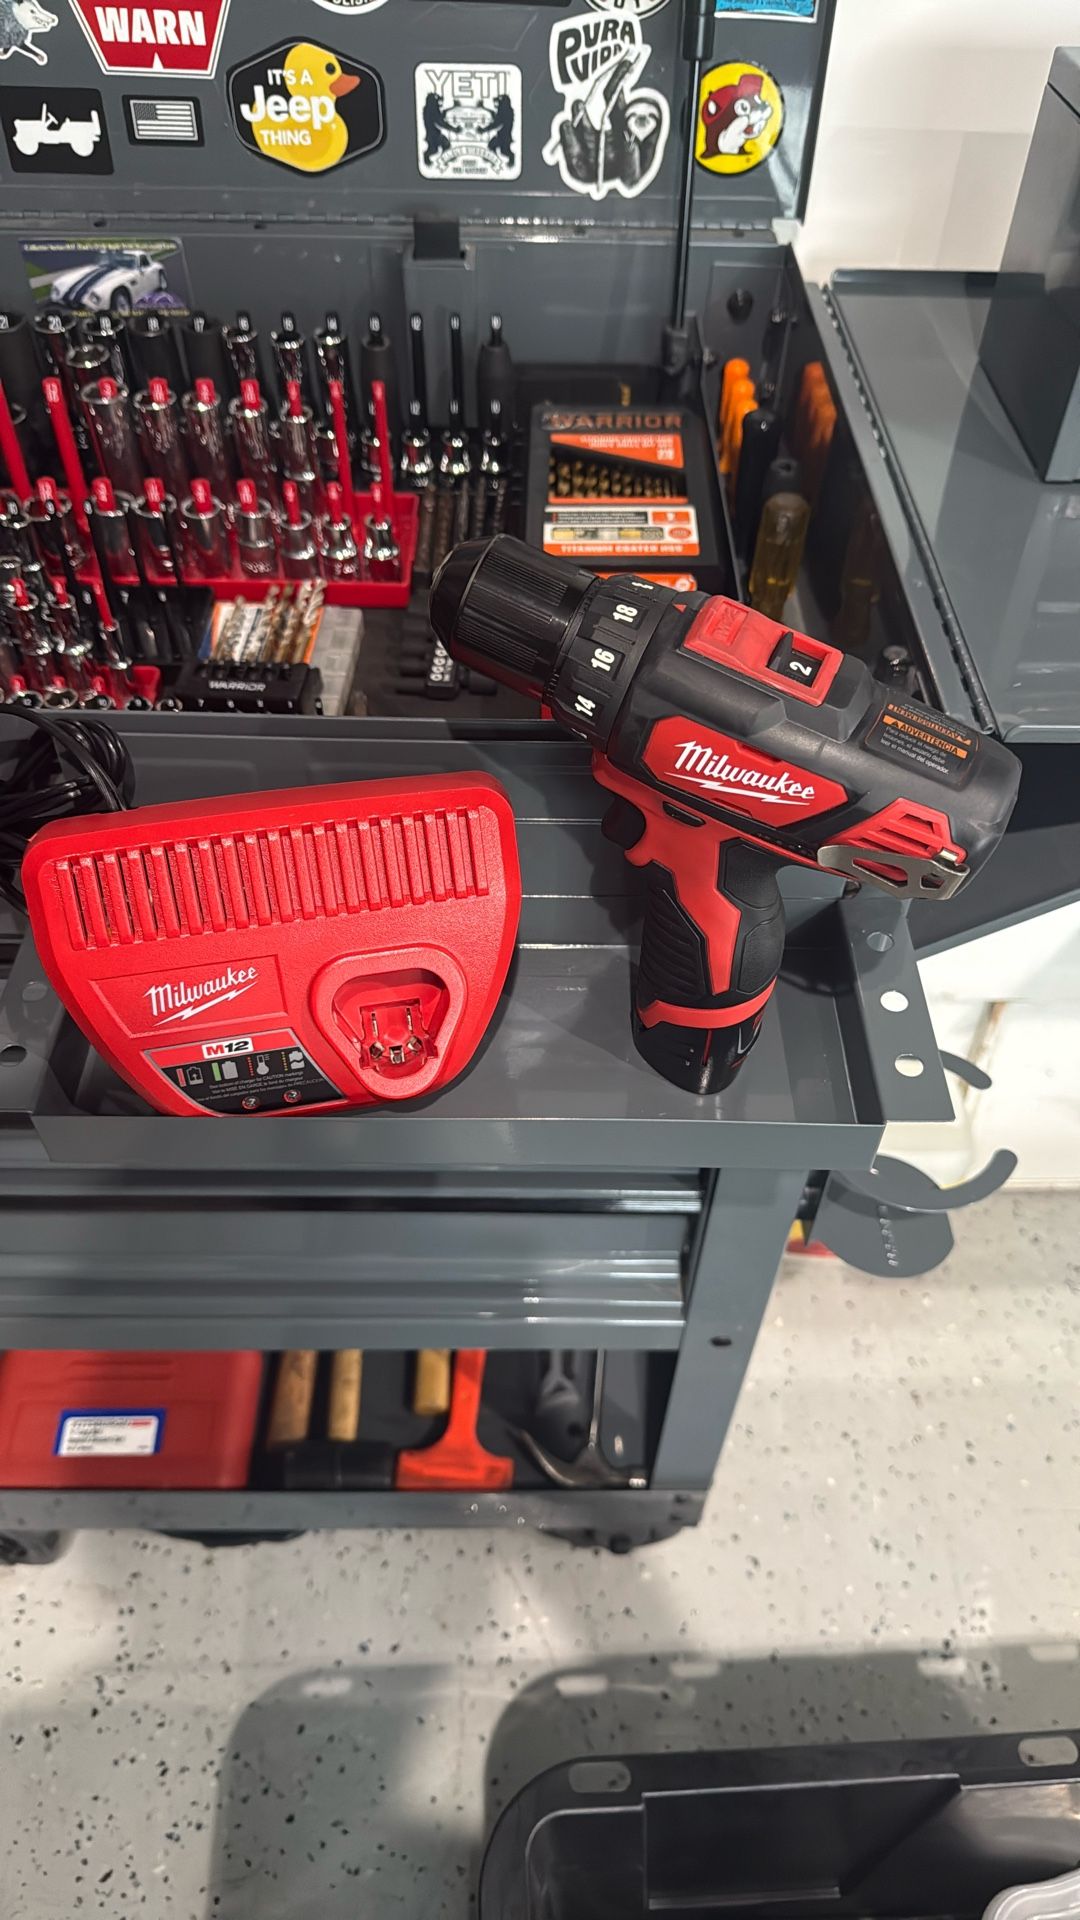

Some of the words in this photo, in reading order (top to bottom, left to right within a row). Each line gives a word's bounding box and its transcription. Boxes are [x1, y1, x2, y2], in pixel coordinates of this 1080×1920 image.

[94, 6, 207, 46] WARN
[557, 19, 636, 84] PURA
[570, 42, 623, 82] VIDA
[267, 69, 297, 86] IT'S
[300, 69, 314, 86] A
[424, 70, 507, 99] YETI
[240, 85, 336, 130] Jeep
[260, 130, 312, 146] THING
[47, 315, 62, 331] 20
[613, 604, 639, 623] 18
[590, 648, 615, 673] 16
[789, 660, 812, 676] 2
[208, 680, 267, 693] WARRIOR
[574, 694, 597, 717] 14
[674, 740, 815, 800] Milwaukee
[142, 966, 260, 1017] Milwaukee
[206, 1040, 250, 1056] M12
